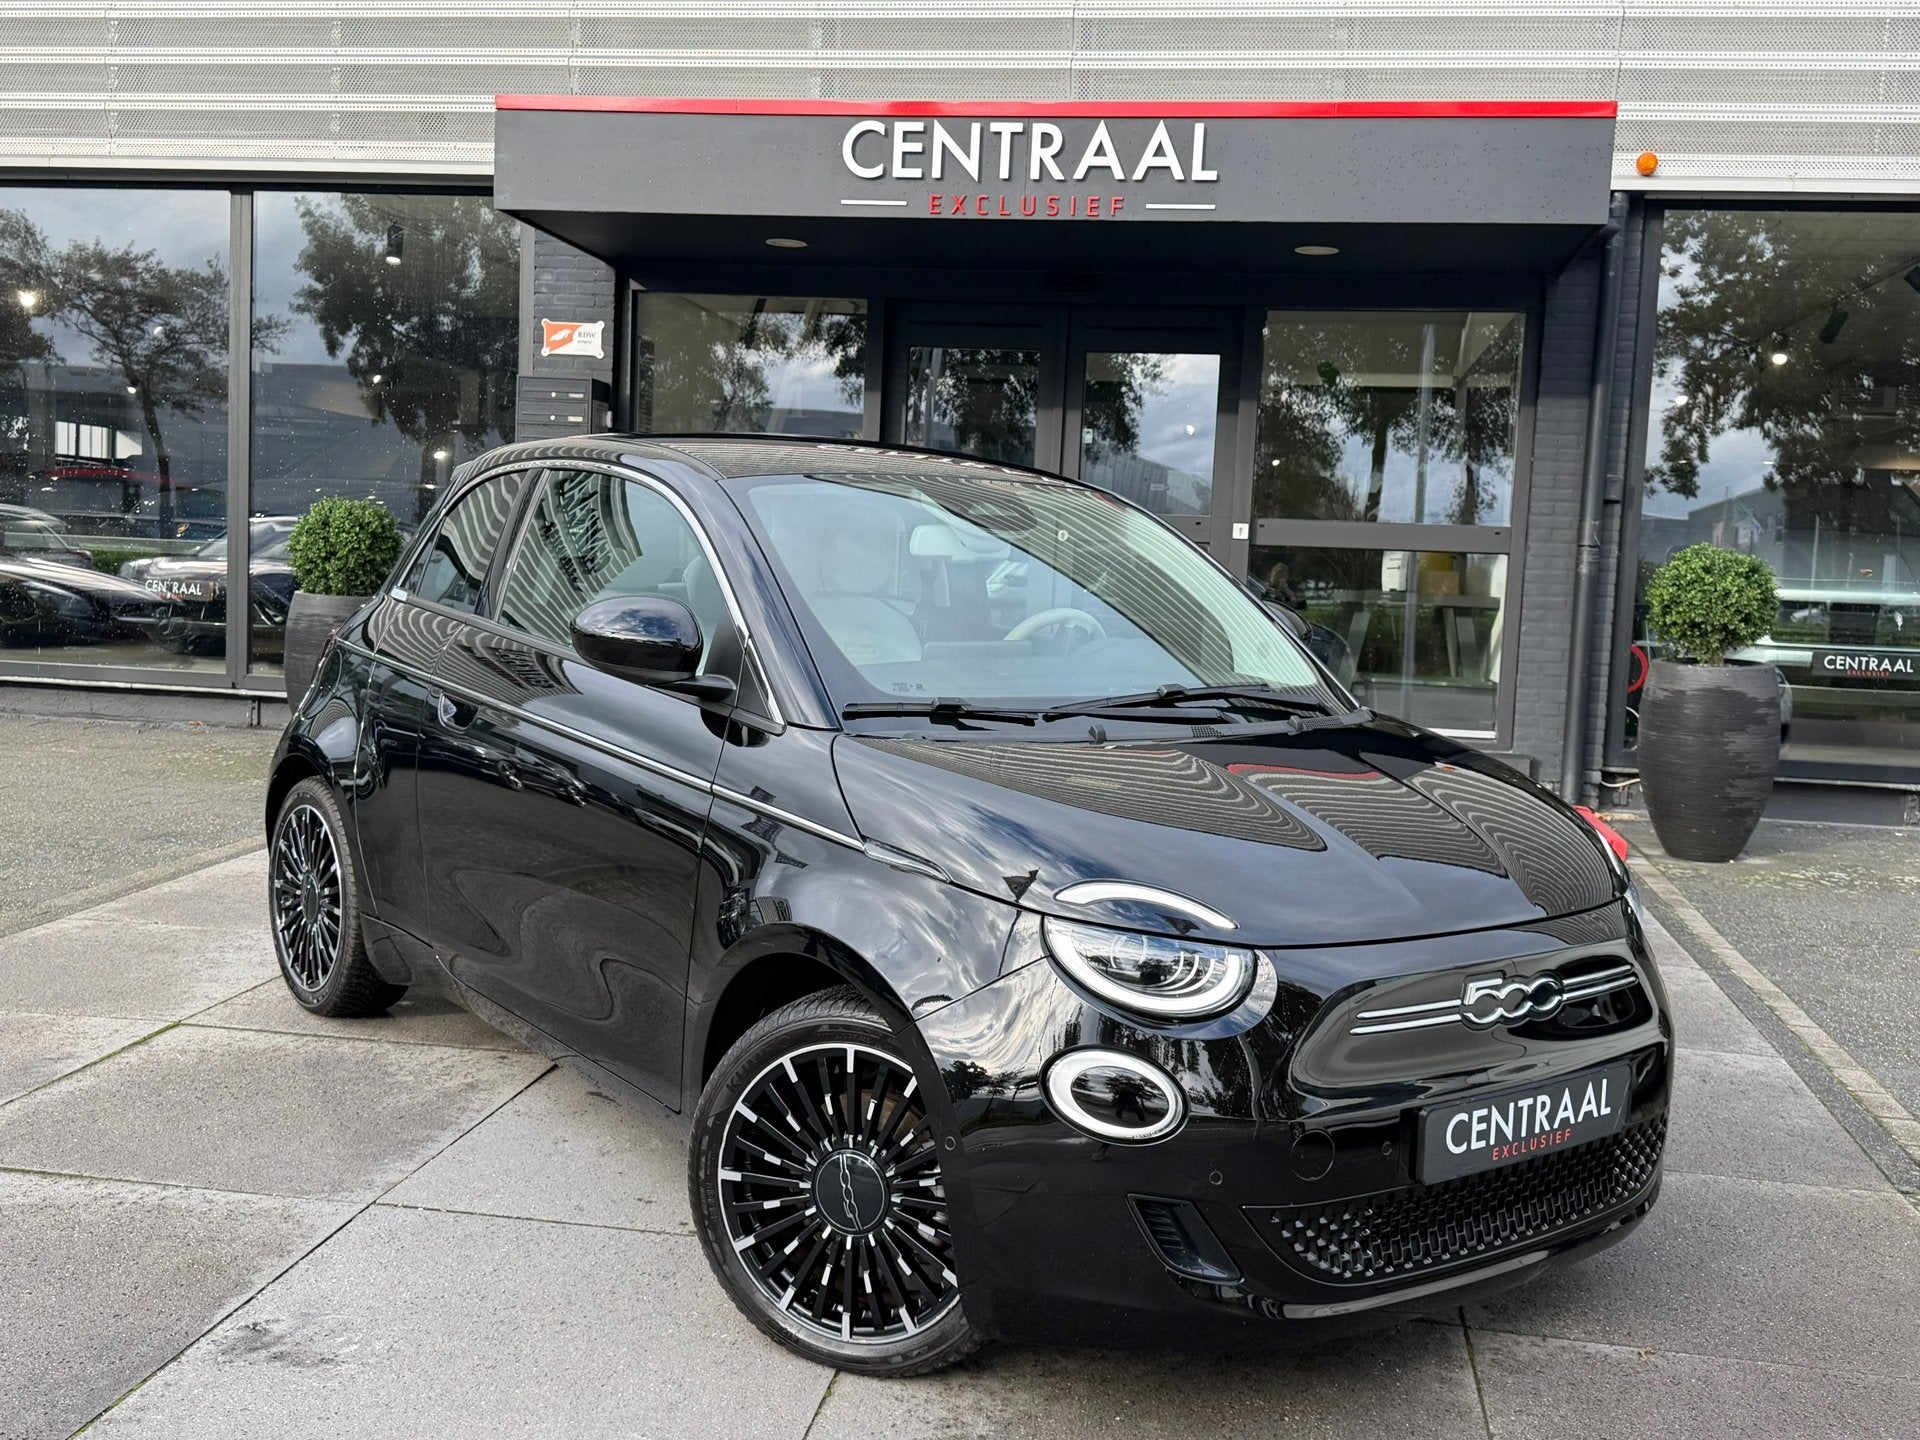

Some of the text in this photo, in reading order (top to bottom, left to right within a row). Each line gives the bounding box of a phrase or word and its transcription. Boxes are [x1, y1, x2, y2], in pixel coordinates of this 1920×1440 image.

[842, 119, 1218, 183] CENTRAAL
[928, 194, 1125, 217] EXCLUSIEF
[145, 579, 202, 596] CENRAAL
[1823, 654, 1914, 673] CENTRAAL
[1463, 978, 1562, 1024] 500
[1445, 1078, 1611, 1154] CENTRAAL
[1492, 1128, 1572, 1161] EXCLUSIEF
